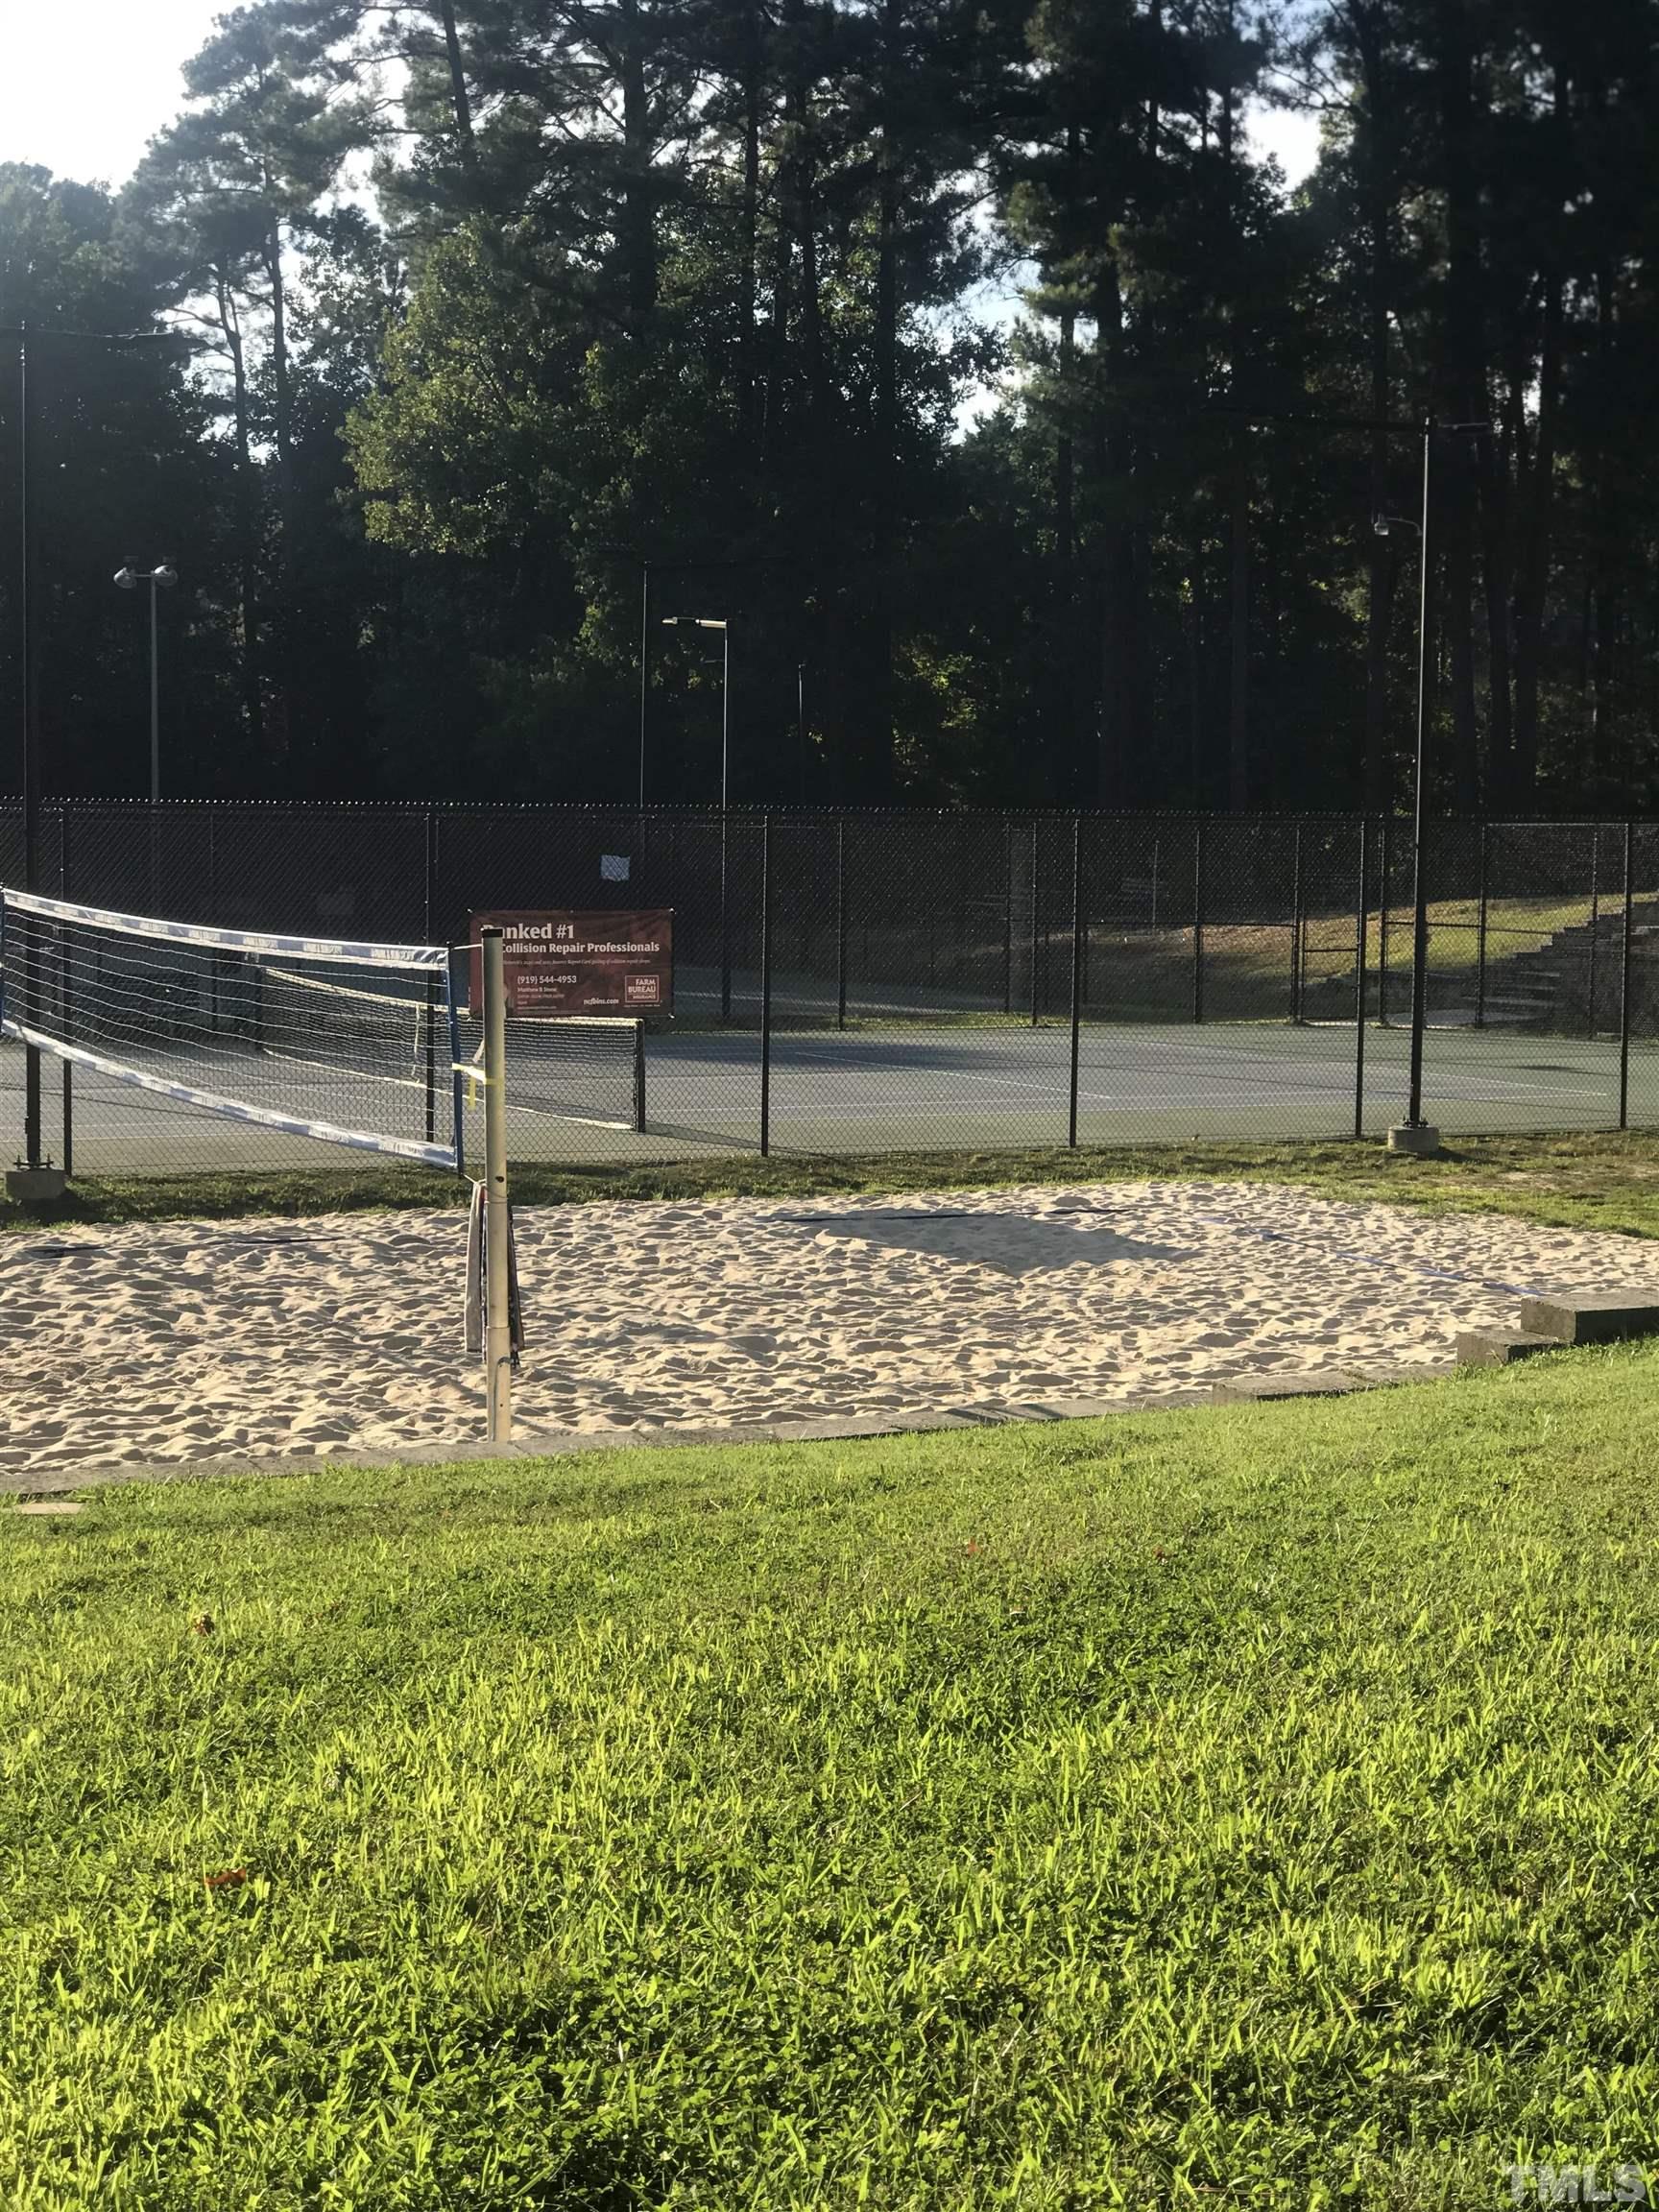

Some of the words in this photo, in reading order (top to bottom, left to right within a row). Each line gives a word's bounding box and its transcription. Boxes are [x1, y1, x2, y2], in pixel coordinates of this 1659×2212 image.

[483, 923, 552, 939] nked
[556, 925, 575, 939] #1
[548, 943, 585, 955] Repair
[587, 941, 660, 953] Professionals
[517, 975, 538, 985] (919)
[539, 974, 577, 984] 544-4953
